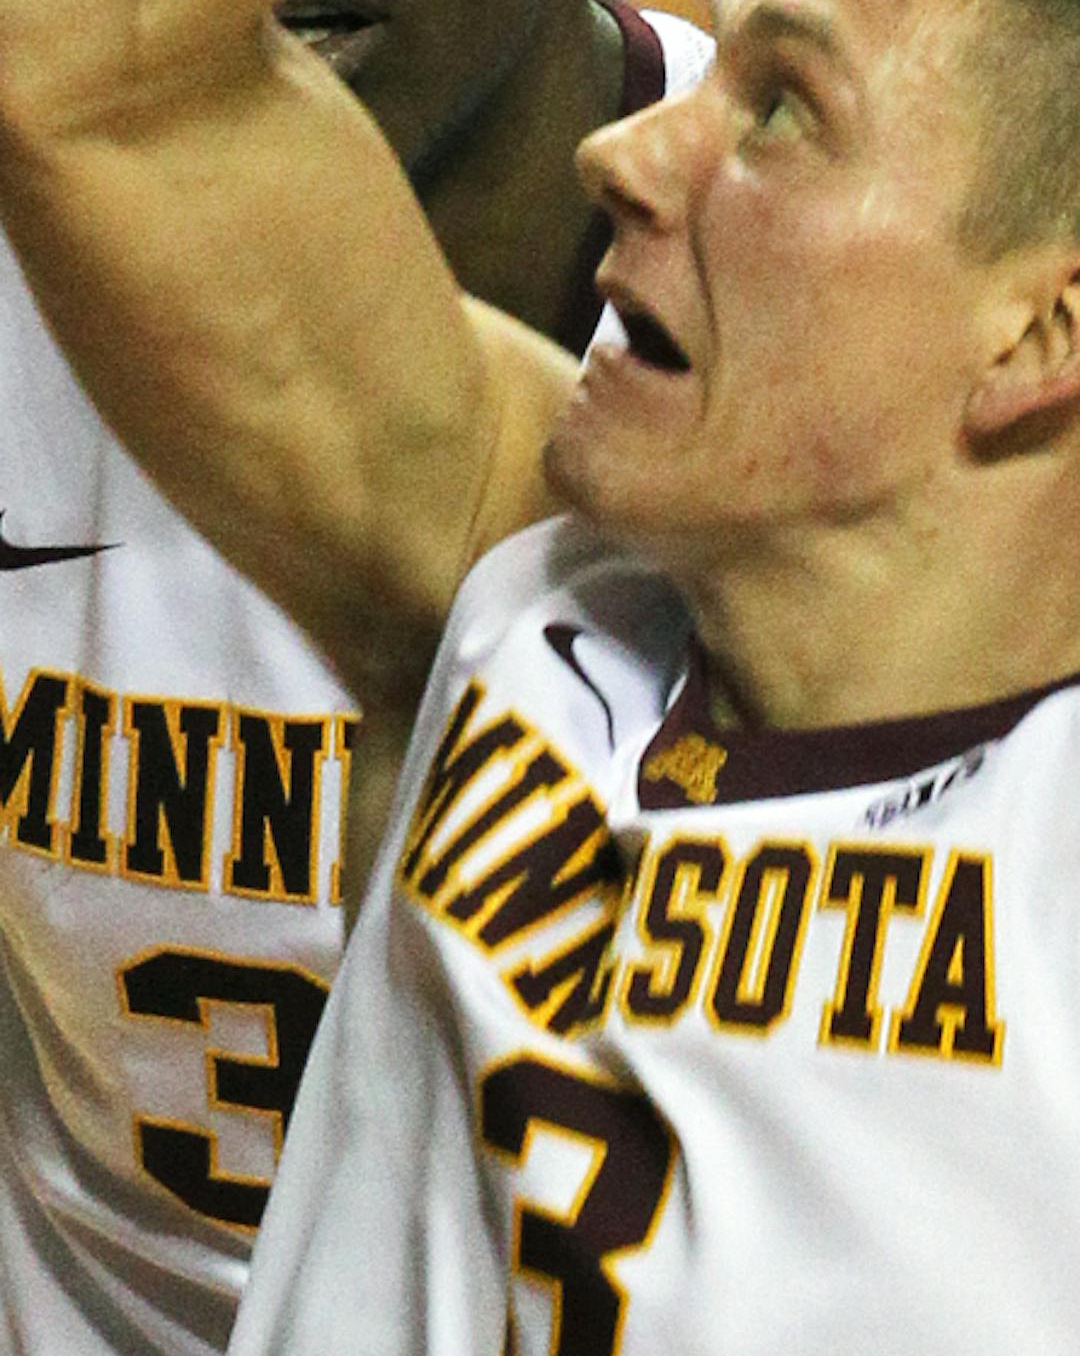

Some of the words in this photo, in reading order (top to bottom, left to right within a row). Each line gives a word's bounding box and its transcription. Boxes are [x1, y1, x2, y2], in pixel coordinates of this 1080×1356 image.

[0, 666, 352, 906] MINN
[398, 678, 1004, 1068] MINNSOTA
[116, 944, 333, 1237] 3
